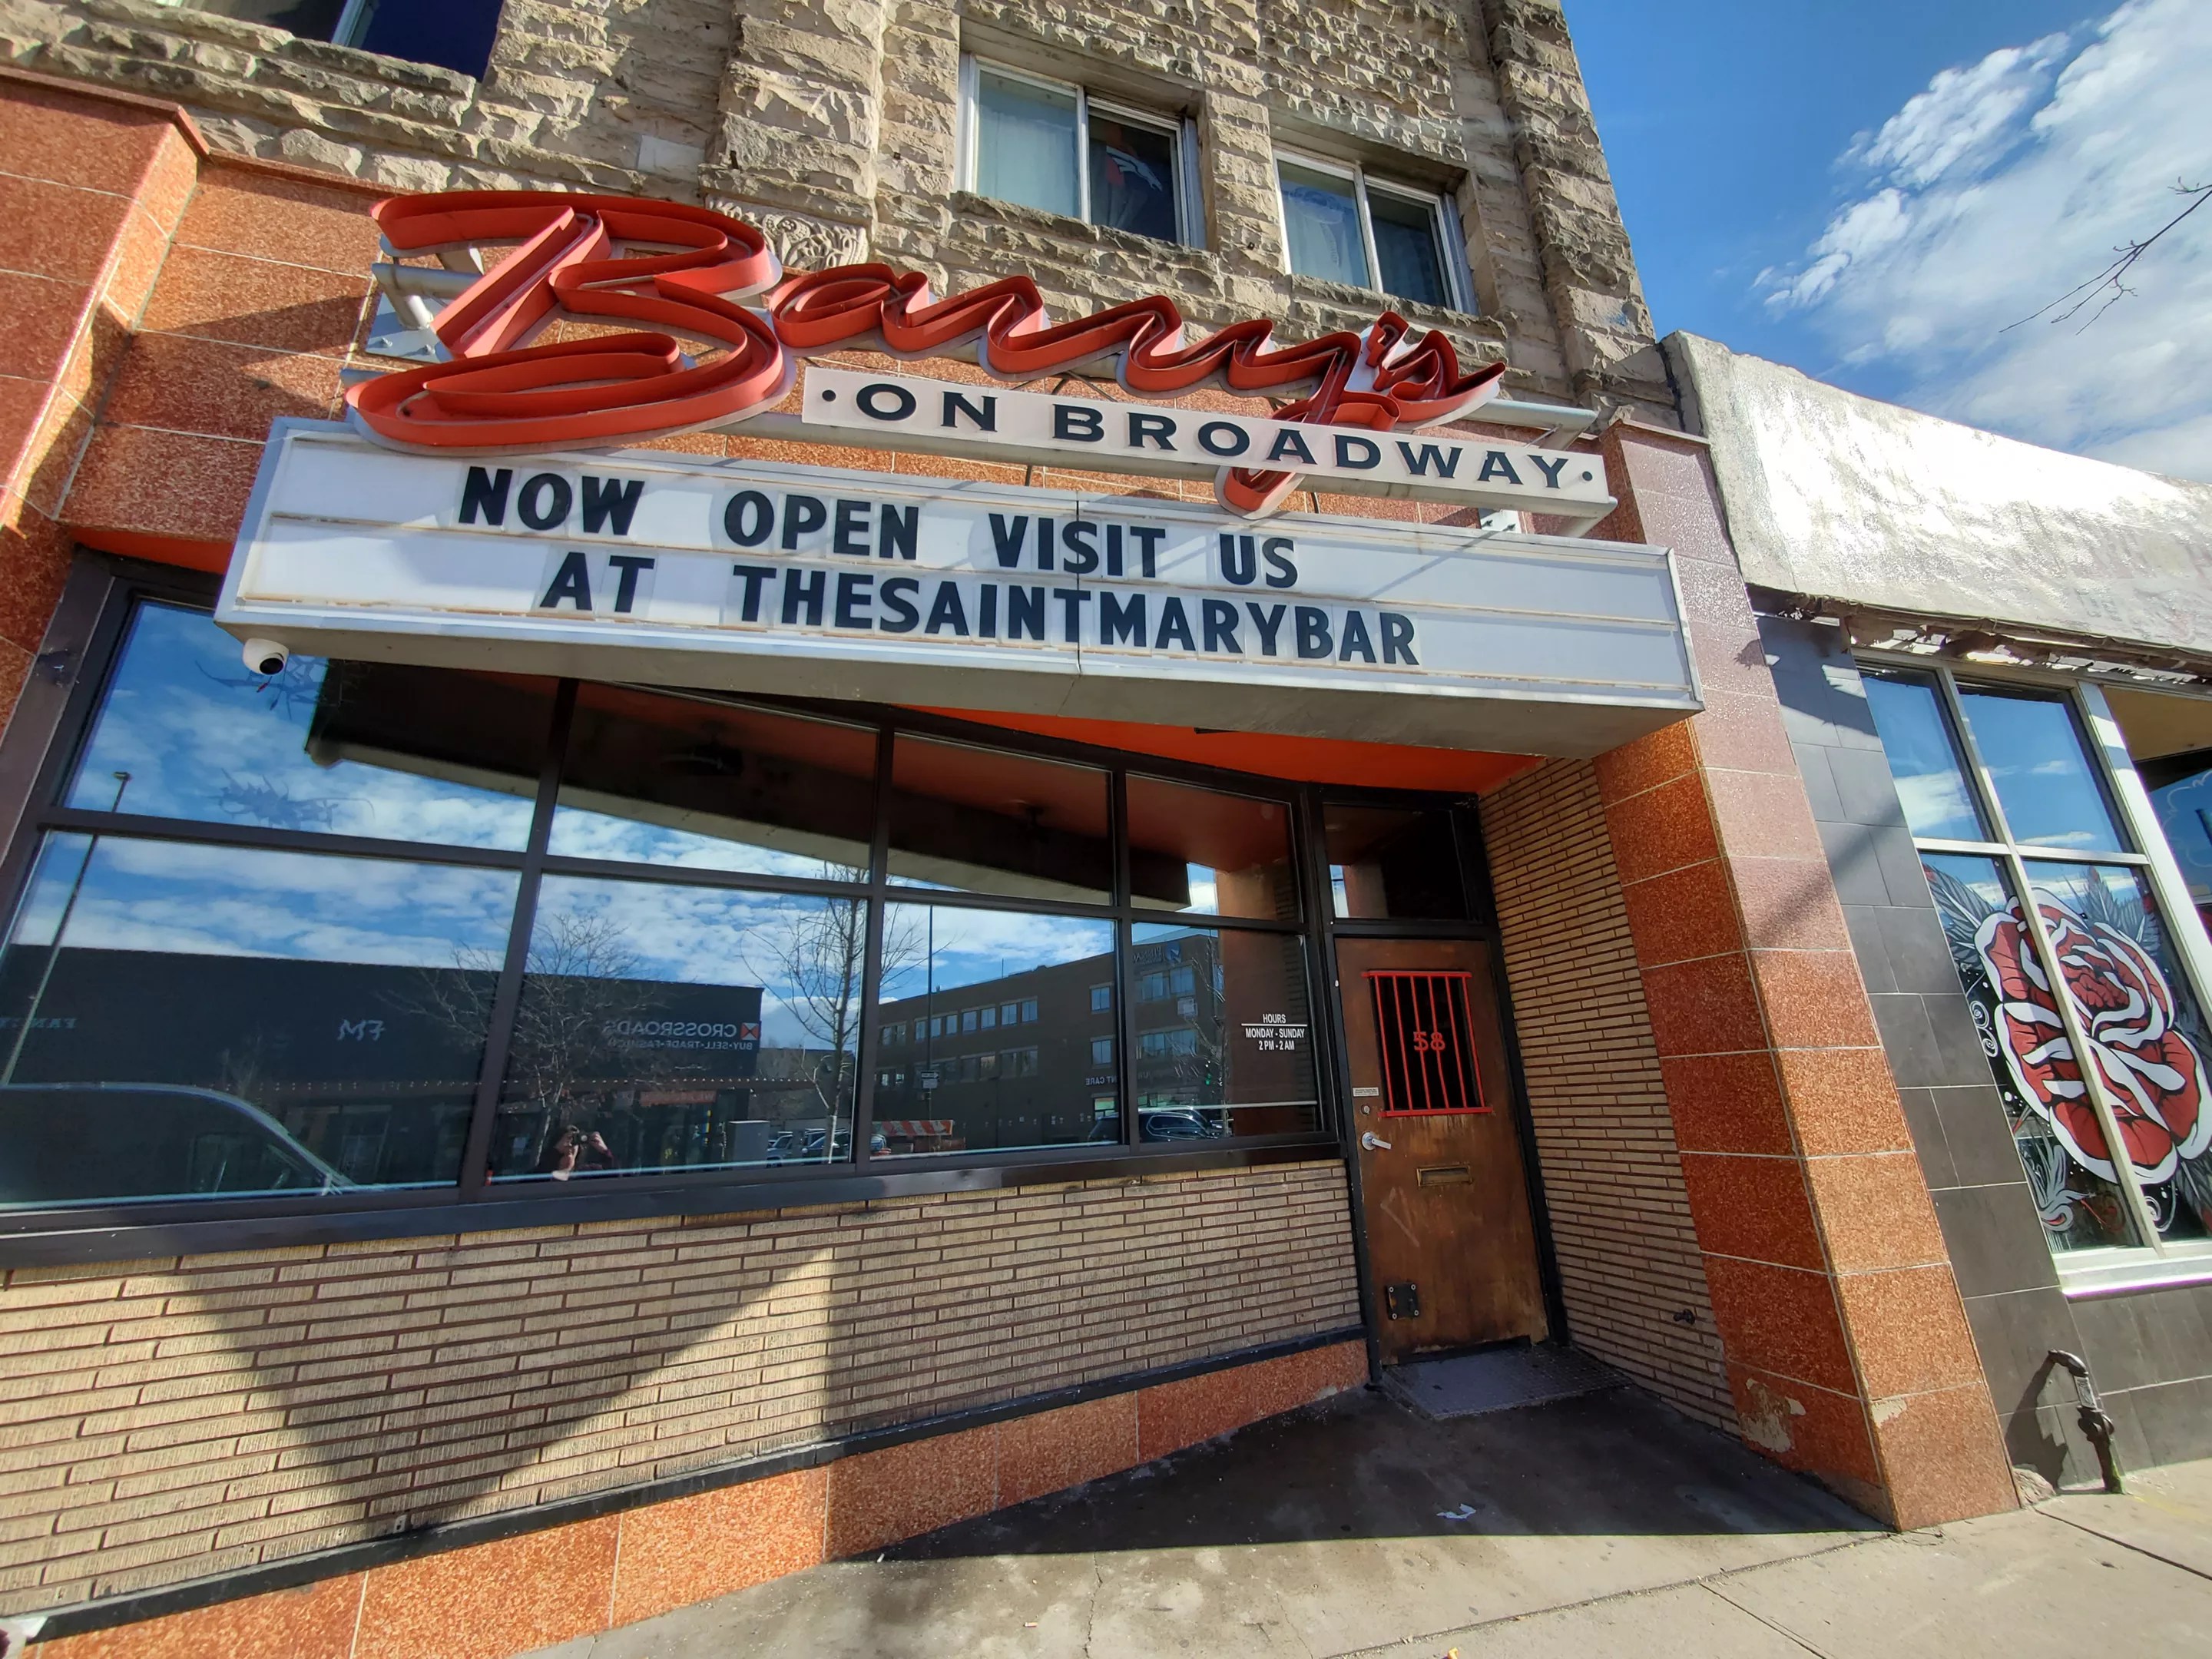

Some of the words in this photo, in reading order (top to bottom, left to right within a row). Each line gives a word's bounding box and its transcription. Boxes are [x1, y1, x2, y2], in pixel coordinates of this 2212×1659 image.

[856, 383, 998, 432] ON
[1052, 403, 1568, 489] BROADWAY
[459, 466, 644, 535] NOW
[724, 490, 919, 560] OPEN
[988, 514, 1165, 578] VISIT
[1220, 533, 1298, 588] US
[540, 551, 655, 612] AT
[733, 565, 1420, 665] THESAINTMARYBAR
[1263, 1013, 1286, 1024] HOURS
[1245, 1028, 1274, 1038] MONDAY
[1278, 1028, 1305, 1038] SUNDAY
[1413, 1031, 1445, 1051] 58
[1259, 1040, 1263, 1050] 2
[1263, 1040, 1275, 1050] PM
[1279, 1040, 1283, 1050] 2
[1284, 1040, 1295, 1050] AM
